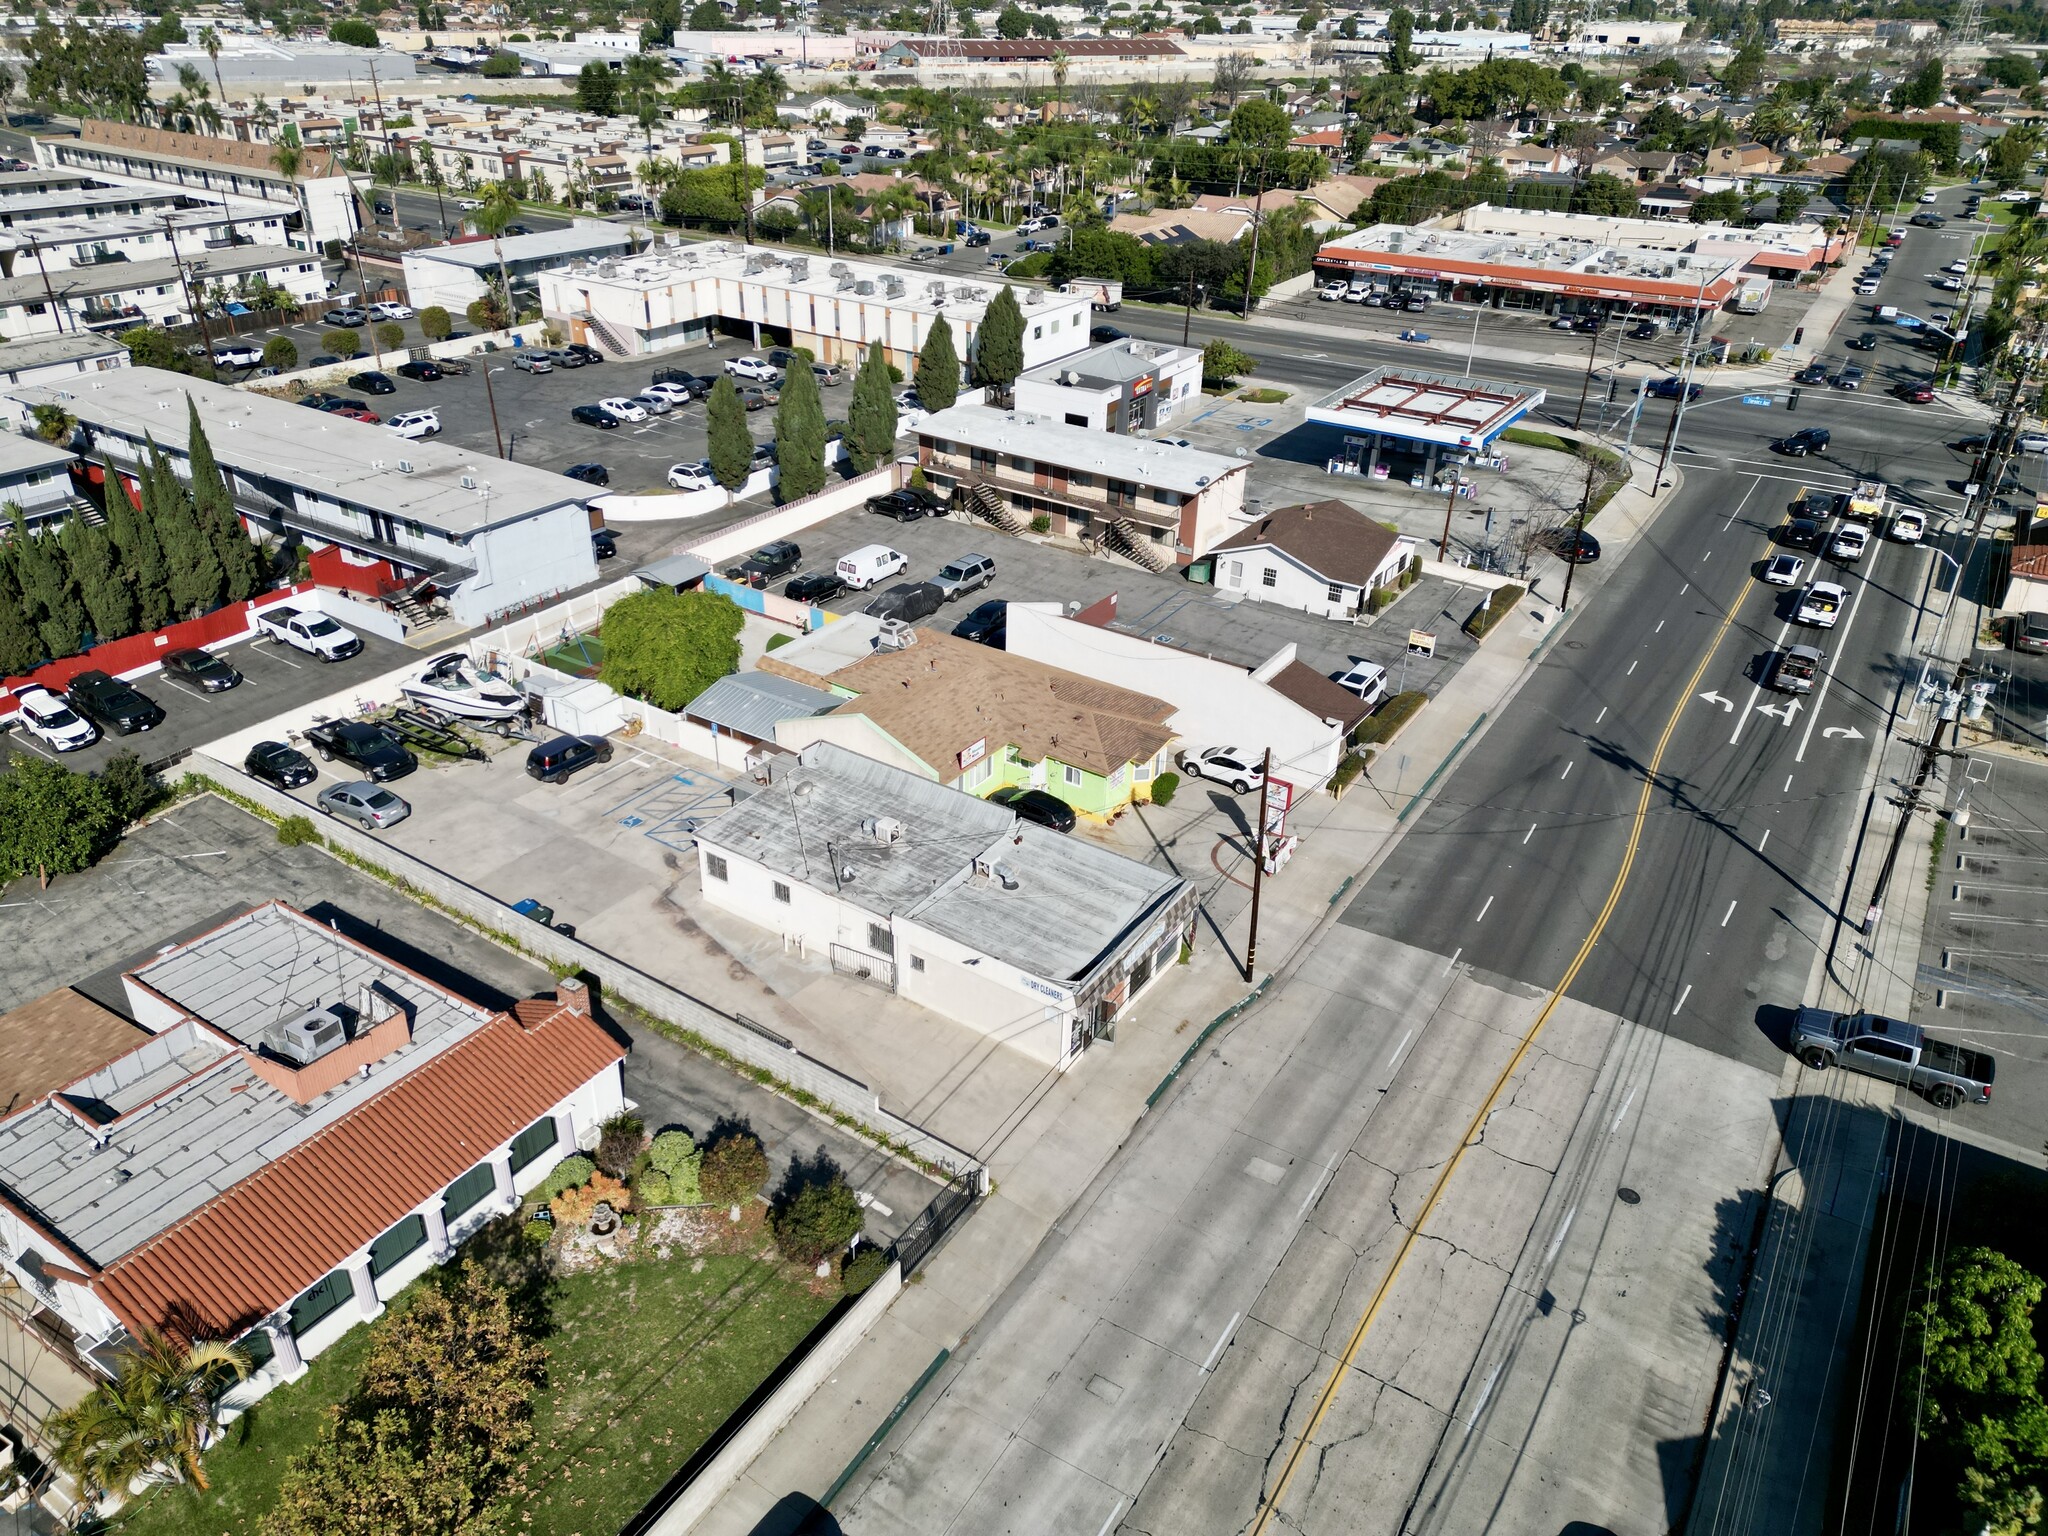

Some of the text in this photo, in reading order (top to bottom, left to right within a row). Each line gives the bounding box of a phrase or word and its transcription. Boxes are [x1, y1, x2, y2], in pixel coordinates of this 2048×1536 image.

[1124, 925, 1165, 968] CLEANERS
[1031, 980, 1040, 991] DRY
[1040, 984, 1063, 1001] CLEANERS
